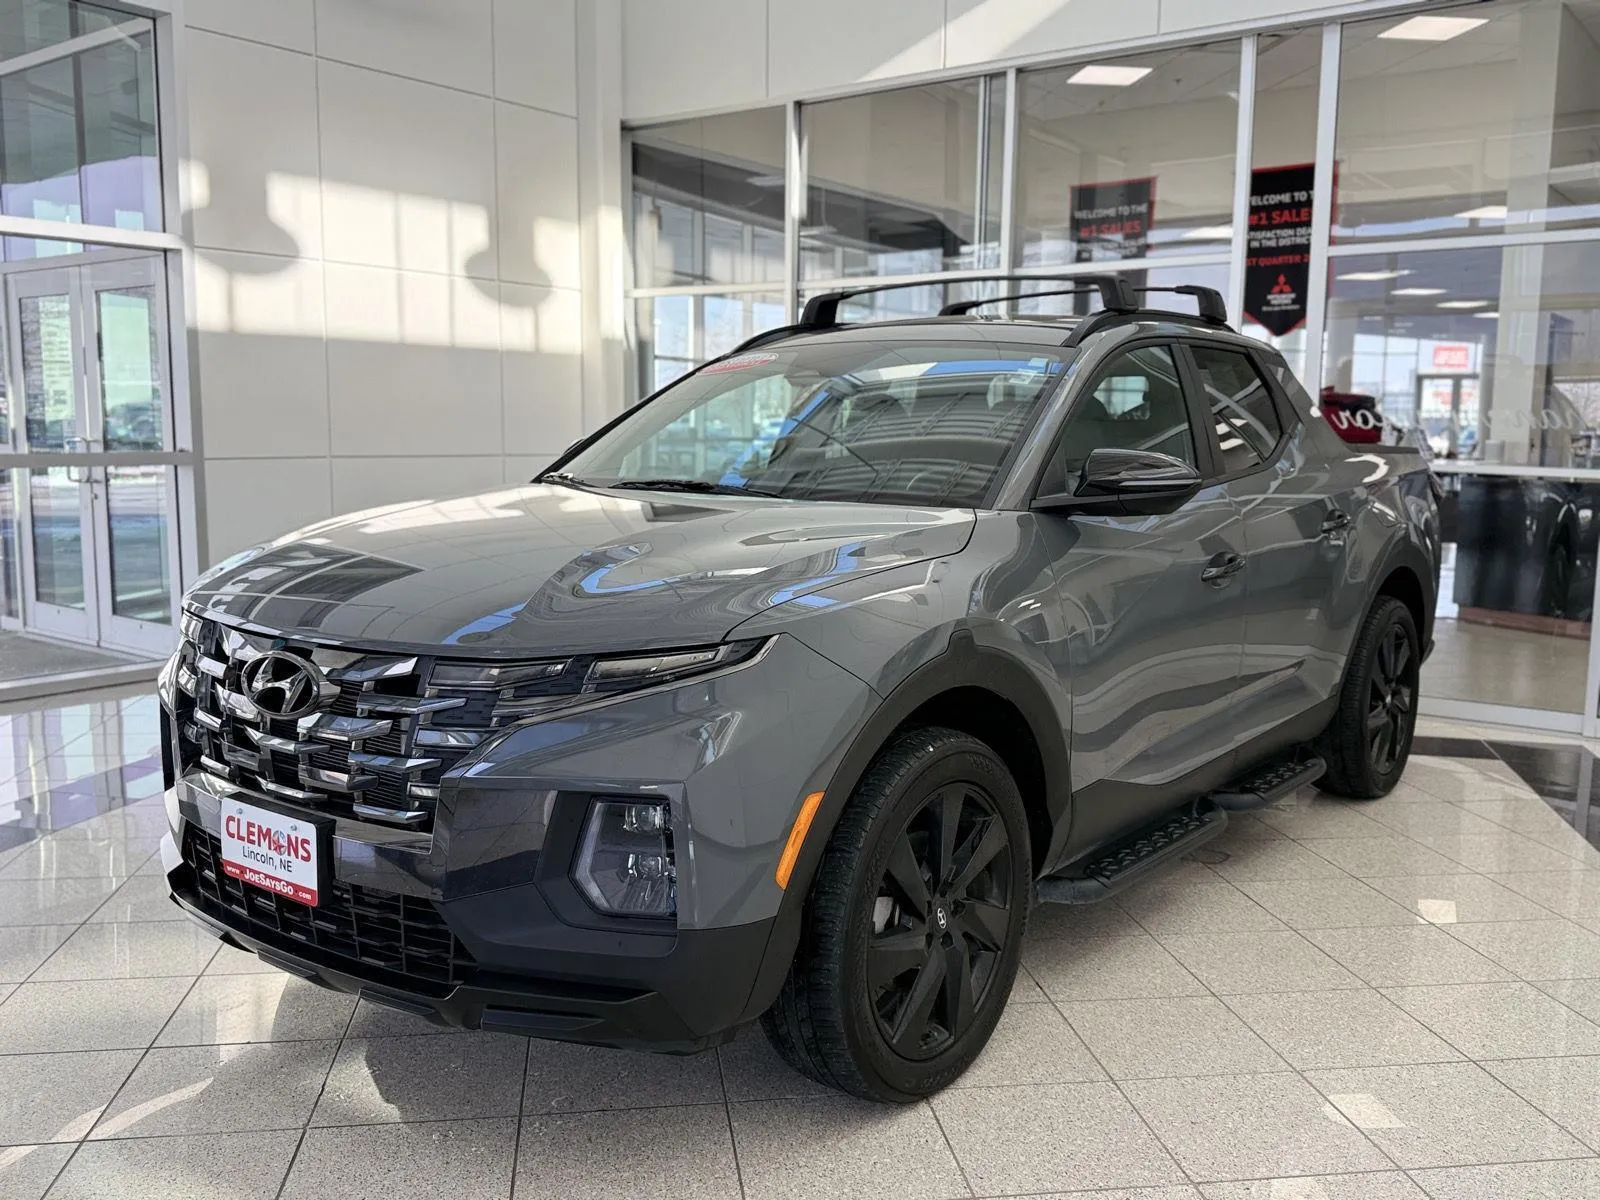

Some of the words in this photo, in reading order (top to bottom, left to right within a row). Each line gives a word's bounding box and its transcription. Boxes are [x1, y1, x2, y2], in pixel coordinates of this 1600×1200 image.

[1249, 193, 1291, 206] ELCOME
[1292, 190, 1308, 202] TO
[1074, 208, 1116, 219] WELCOME
[1118, 205, 1130, 216] TO
[1271, 207, 1311, 224] SALE
[1100, 220, 1141, 235] SALES
[226, 816, 311, 862] CLEMONS
[243, 846, 276, 870] Lincoln,
[280, 860, 292, 872] NE
